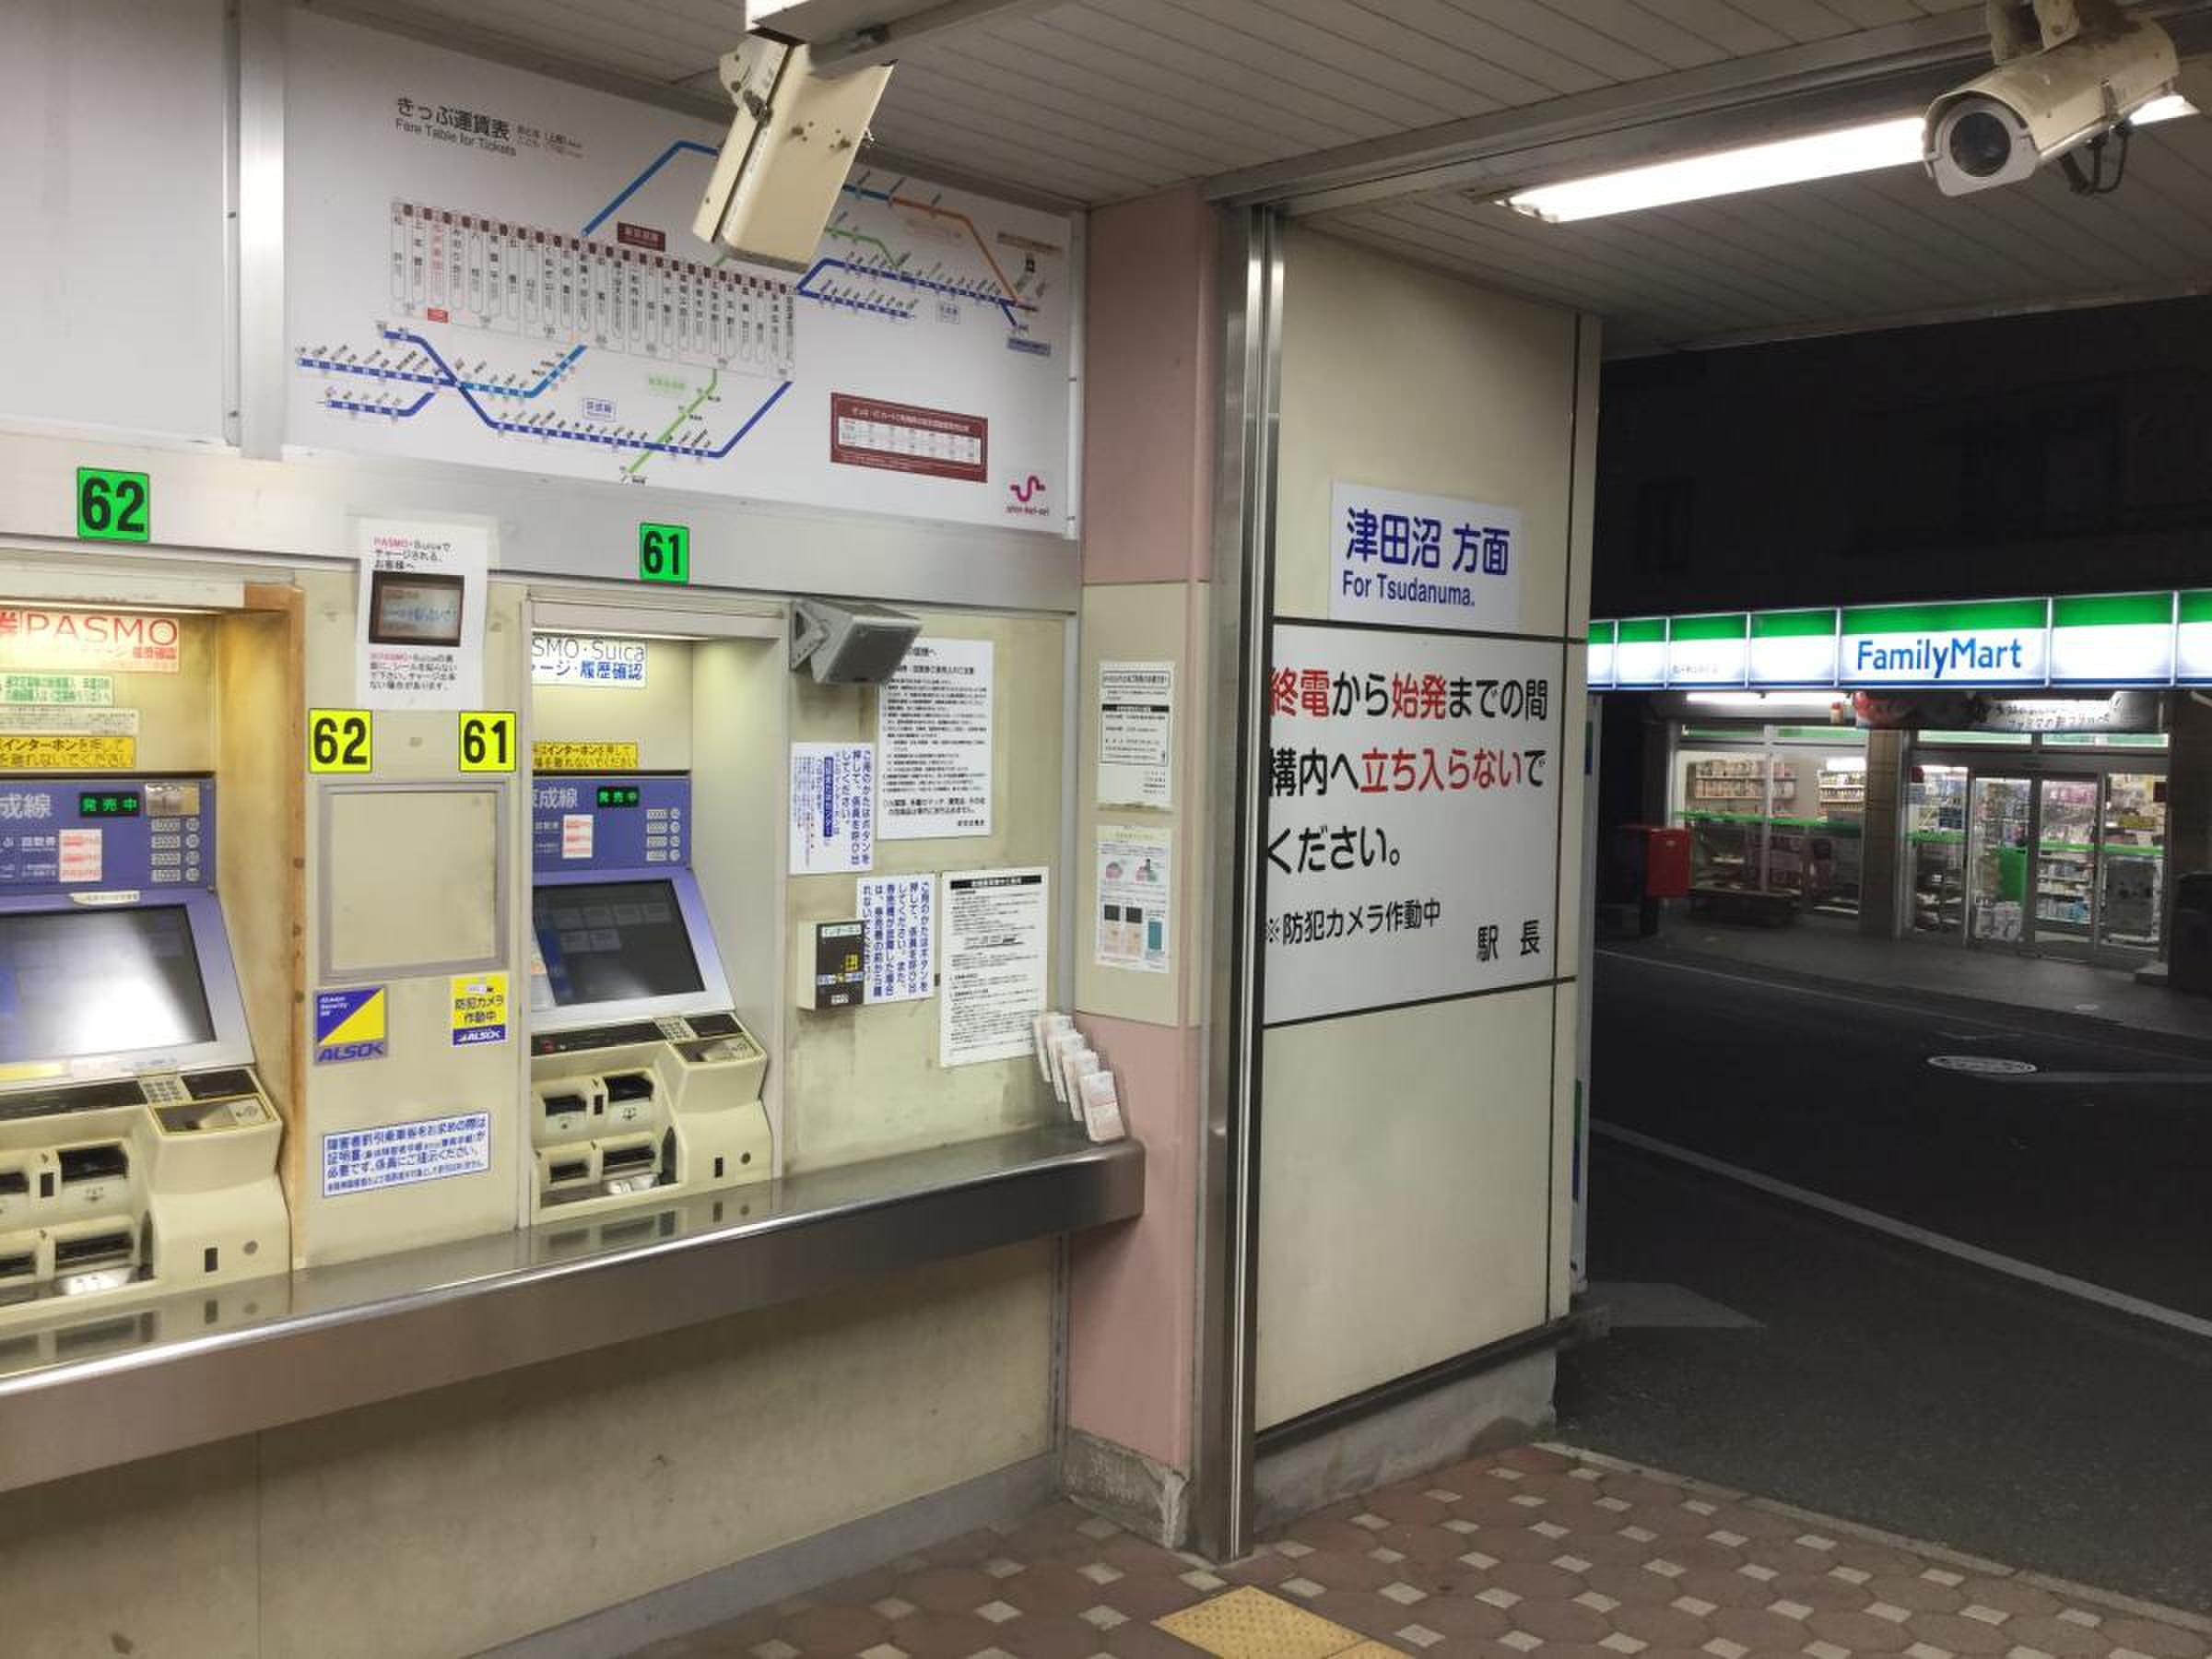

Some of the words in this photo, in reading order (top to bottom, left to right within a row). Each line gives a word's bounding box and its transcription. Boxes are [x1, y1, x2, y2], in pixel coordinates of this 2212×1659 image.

[82, 477, 144, 533] 62
[643, 530, 680, 577] 61
[1347, 507, 1441, 569] 津田沼
[1453, 523, 1511, 576] 方面
[1343, 570, 1371, 598] For
[1377, 572, 1475, 606] Tsudanuma.
[1858, 637, 2022, 679] FamilyMart
[1269, 667, 1547, 721] 終電から始発までの間
[313, 716, 367, 765] 62
[464, 719, 506, 764] 61
[1269, 747, 1546, 797] 構内へ立ち入らないで
[82, 797, 138, 812] 発売中
[1268, 825, 1400, 875] ください。
[1267, 898, 1441, 946] ※防犯カメラ作動中
[454, 995, 504, 1010] 防犯カメラ
[464, 1011, 497, 1025] 作動中
[319, 1044, 383, 1061] ALSOK
